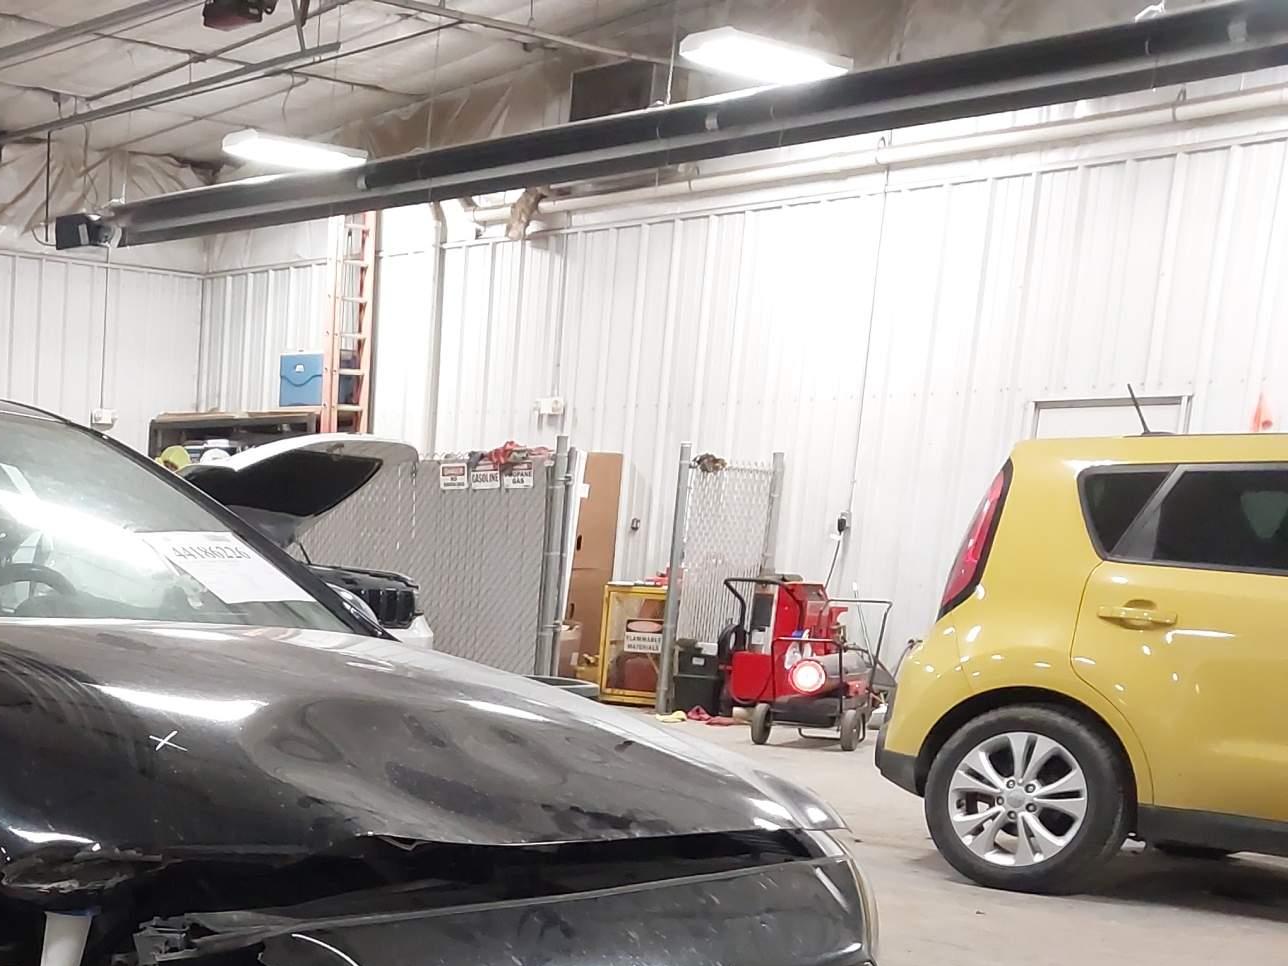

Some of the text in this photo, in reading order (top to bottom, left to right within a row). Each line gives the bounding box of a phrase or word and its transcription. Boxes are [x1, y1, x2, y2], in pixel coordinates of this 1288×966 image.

[472, 473, 498, 482] GASOLINE
[171, 546, 252, 560] 44186226
[626, 635, 661, 643] FLAMMABLE
[627, 643, 659, 651] MATERIALS
